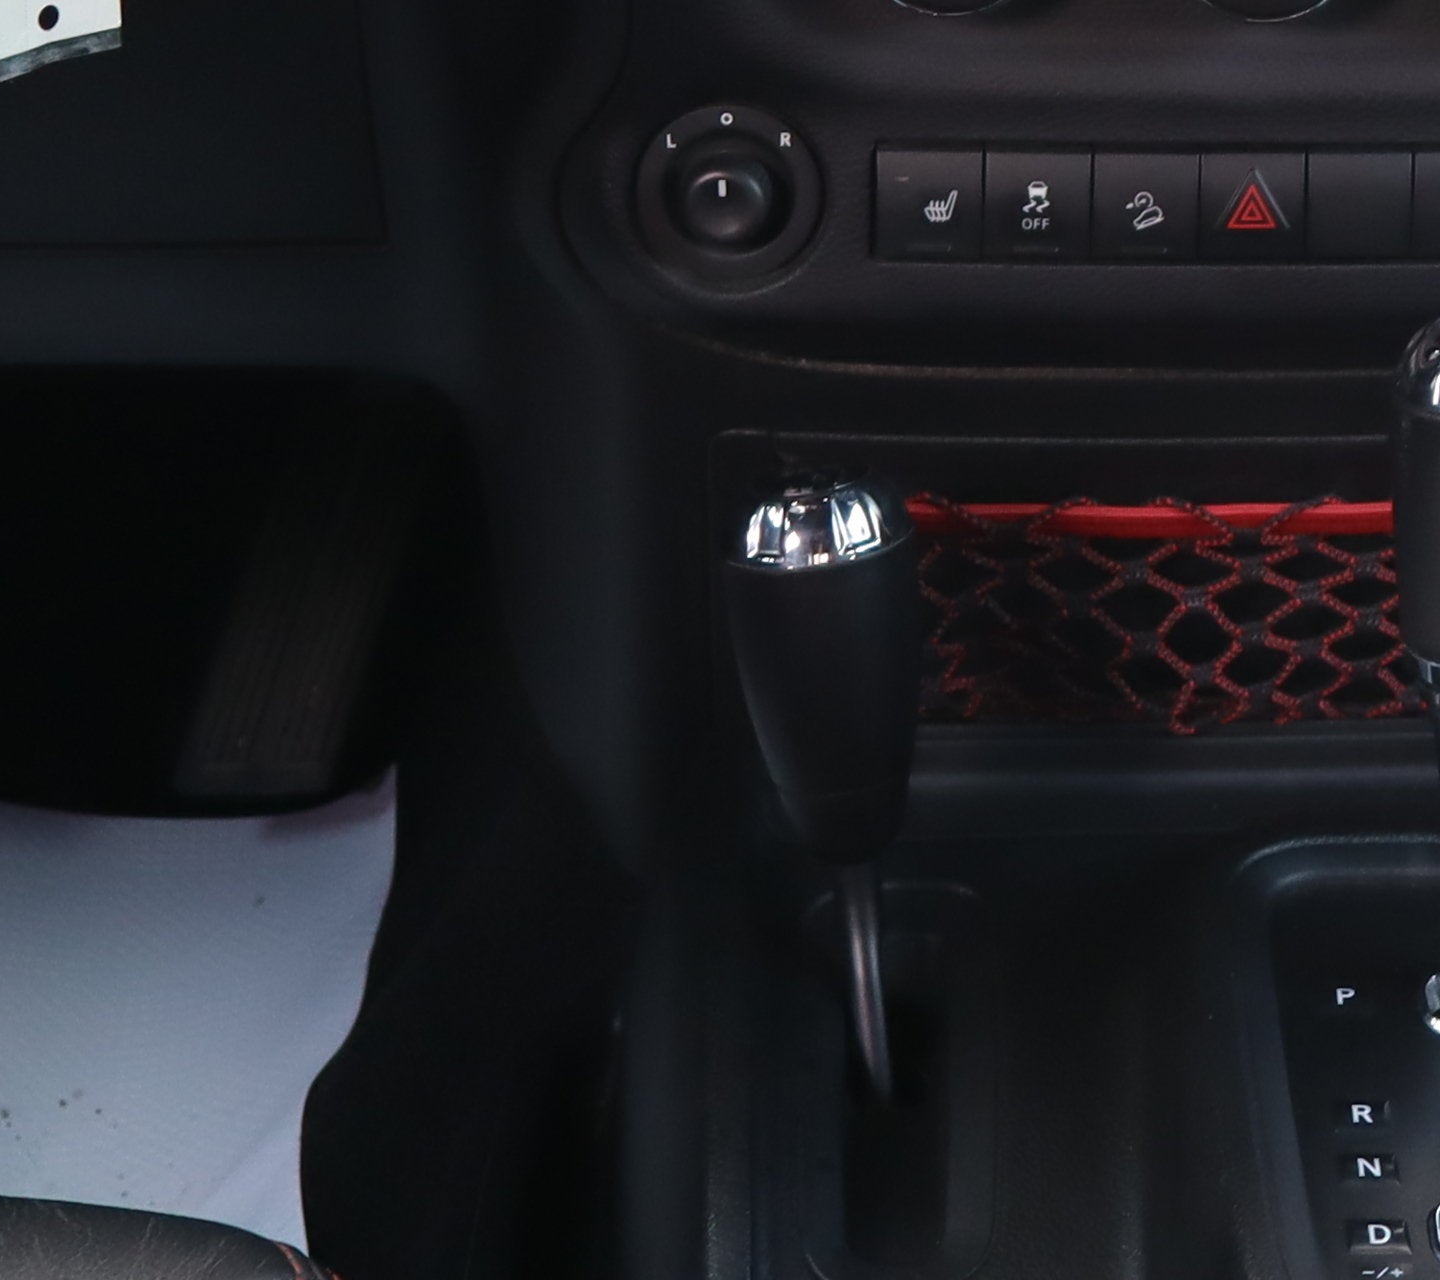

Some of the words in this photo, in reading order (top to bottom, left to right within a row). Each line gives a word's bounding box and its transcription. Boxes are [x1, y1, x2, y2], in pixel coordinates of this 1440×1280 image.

[665, 133, 677, 149] L
[779, 131, 792, 148] R
[1021, 217, 1051, 231] OFF
[1335, 987, 1356, 1006] P
[1351, 1104, 1374, 1125] R
[1356, 1157, 1383, 1179] N
[1367, 1223, 1393, 1245] D
